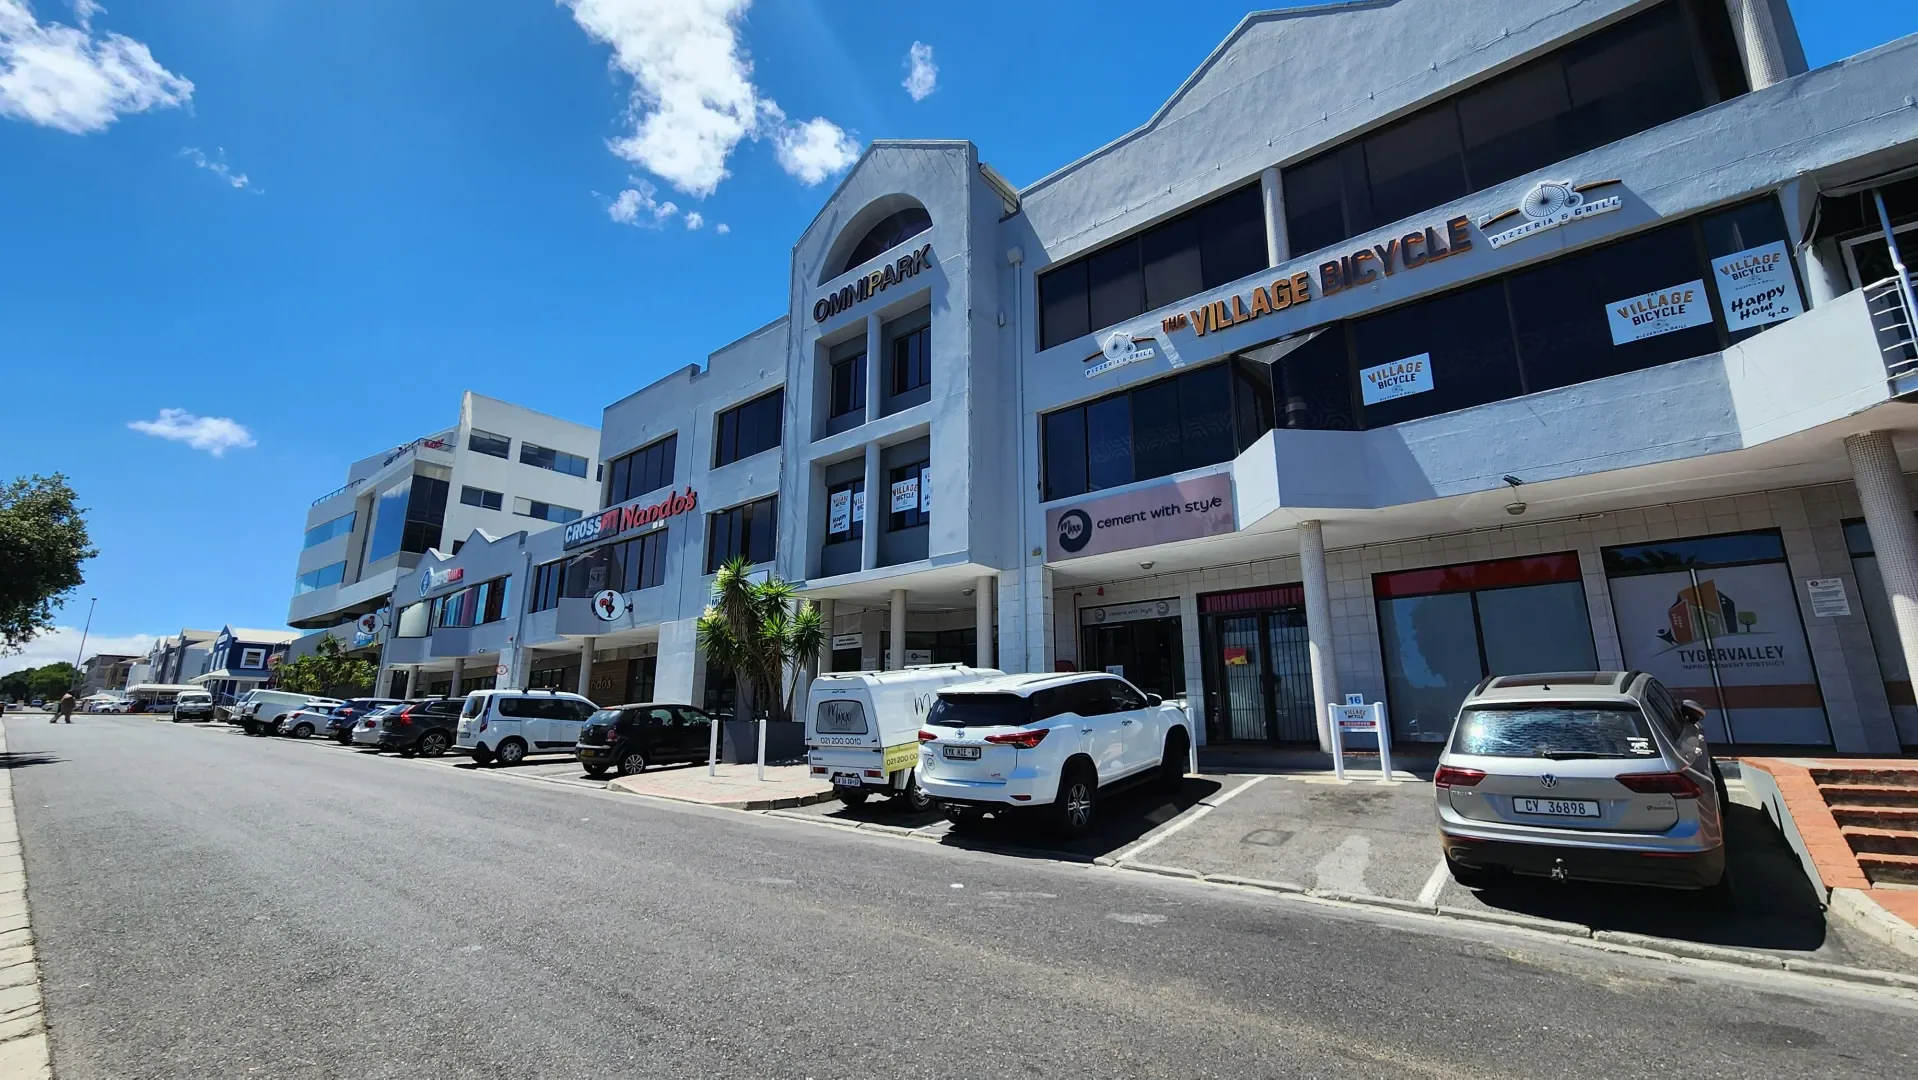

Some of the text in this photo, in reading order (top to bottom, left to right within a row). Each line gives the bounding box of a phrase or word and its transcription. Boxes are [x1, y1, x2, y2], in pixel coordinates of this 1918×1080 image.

[1491, 218, 1554, 245] PIZZERIA
[1574, 199, 1620, 216] GRILL
[1720, 252, 1781, 276] VILLAGE
[1731, 263, 1775, 281] BICYCLE
[813, 243, 932, 323] OMNIPARK
[1160, 215, 1473, 336] THE VILLAGE BICYCLE
[1616, 289, 1694, 319] VILLAGE
[1731, 284, 1786, 313] Happy
[1631, 304, 1686, 326] BICYCLE
[1739, 302, 1774, 321] Hour
[1086, 359, 1120, 376] PIZZERIA
[1129, 350, 1153, 360] GRILL
[1367, 361, 1423, 384] VILLAGE
[1377, 373, 1416, 390] BICYCLE
[892, 484, 918, 497] VILLAGE
[896, 492, 915, 502] BICYCLE
[621, 486, 698, 532] Nando's
[1096, 496, 1222, 529] cement with style
[1677, 645, 1784, 663] TYGRVALLEY
[1348, 696, 1361, 704] 16
[831, 737, 844, 745] 200
[845, 737, 861, 746] 0010
[1525, 800, 1586, 815] CY 36898
